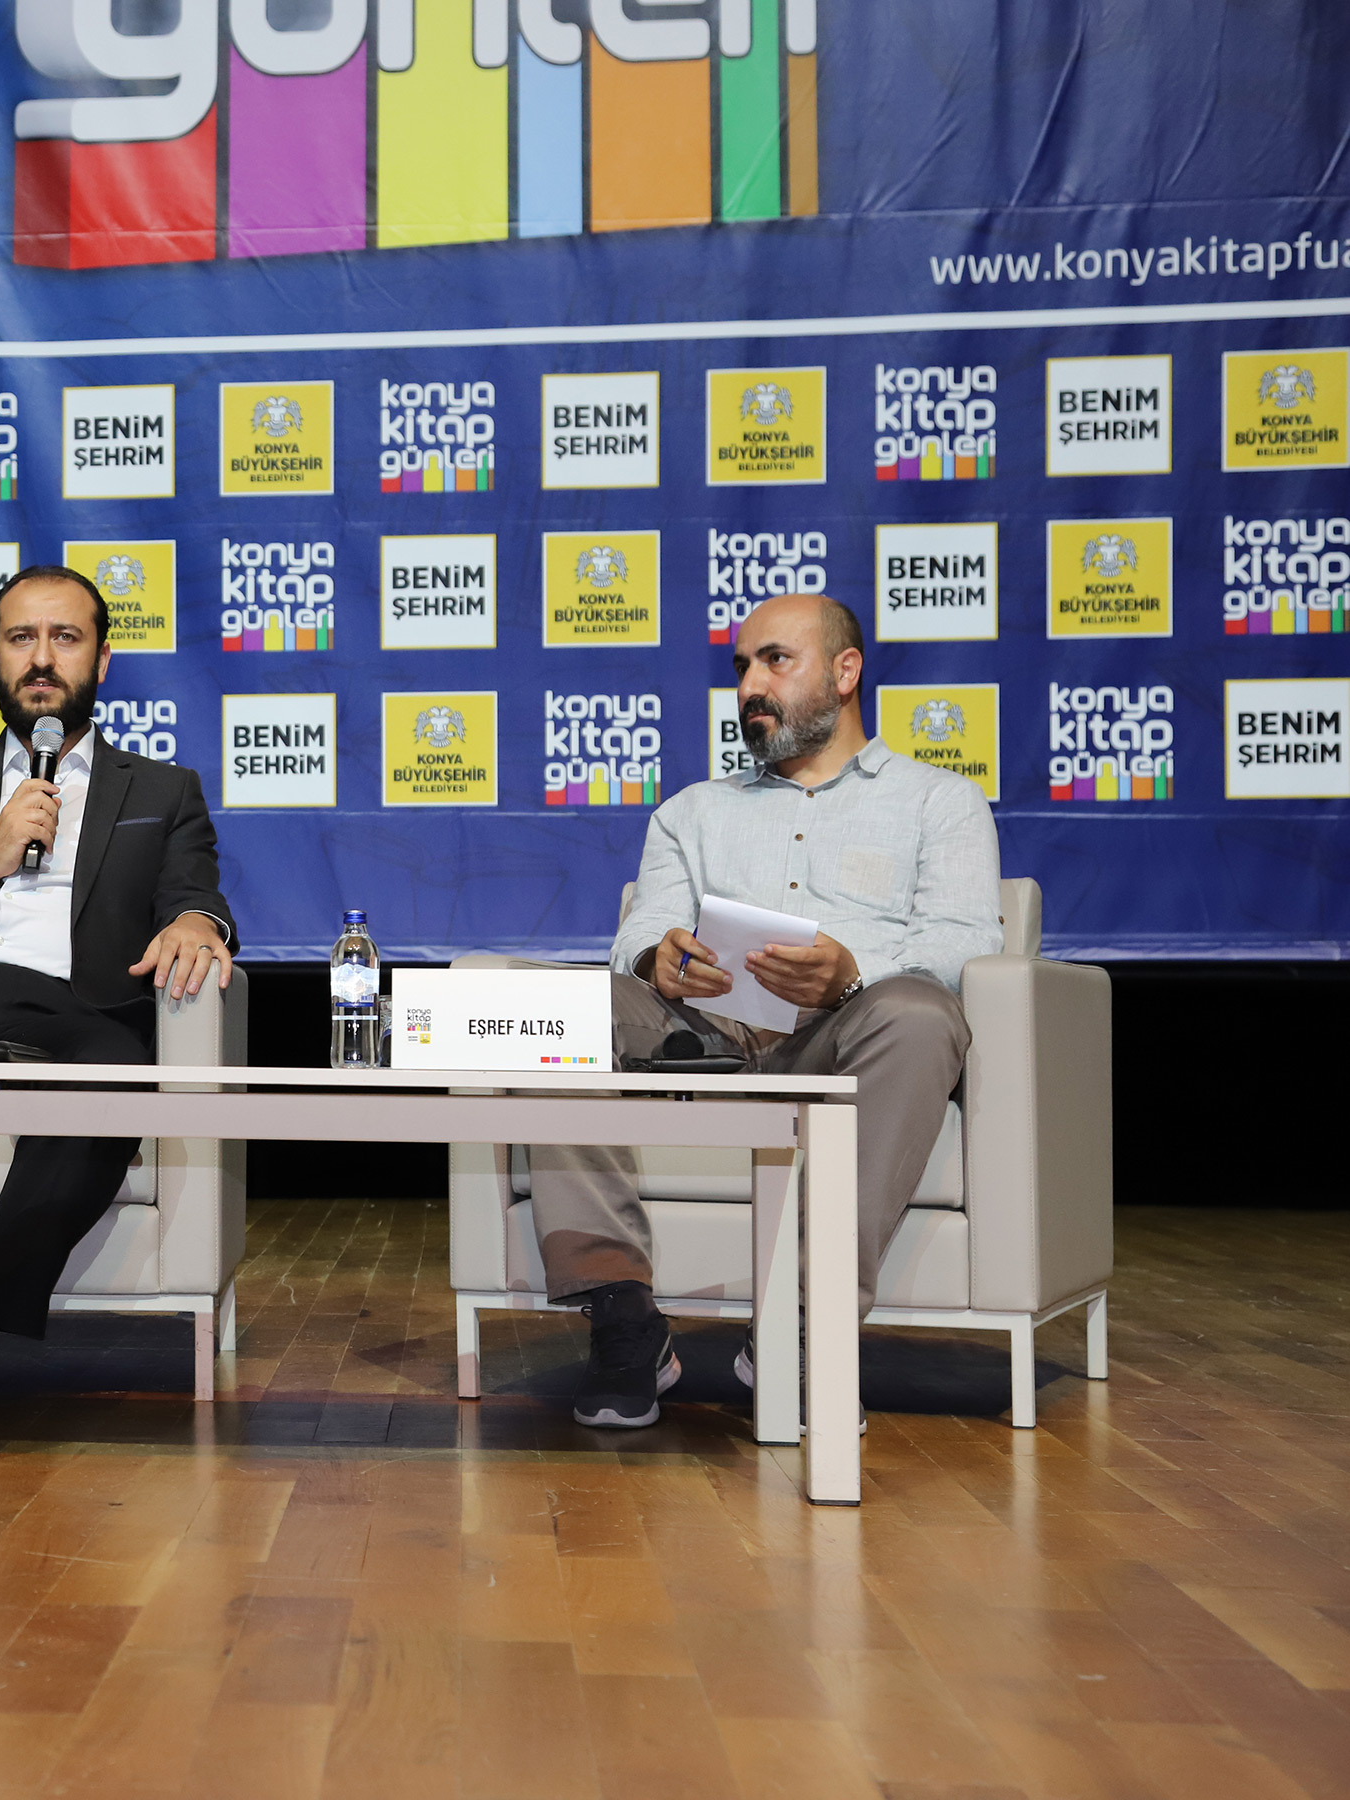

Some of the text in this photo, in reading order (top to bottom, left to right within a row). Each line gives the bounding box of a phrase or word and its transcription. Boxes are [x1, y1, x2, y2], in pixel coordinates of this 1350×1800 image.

[380, 379, 495, 415] konya
[875, 364, 996, 400] konya
[380, 408, 495, 449] kitap
[875, 393, 996, 435] kitap
[1262, 415, 1312, 427] KONYA
[255, 443, 299, 454] KONYA
[719, 443, 813, 461] BÜYÜKŞEHİR
[743, 431, 789, 442] KONYA
[875, 429, 996, 467] günleri
[1235, 426, 1338, 446] BÜYÜKŞEHİR
[232, 456, 322, 472] BÜYÜKŞEHİR
[380, 444, 495, 479] günleri
[708, 528, 828, 566] konya
[1224, 516, 1350, 552] konya
[222, 538, 334, 574] konya
[1224, 545, 1350, 586] kitap
[222, 567, 334, 608] kitap
[708, 558, 828, 596] kitap
[1085, 584, 1134, 595] KONYA
[107, 601, 143, 612] ONYA
[555, 606, 648, 623] BÜYÜKŞEHİR
[579, 594, 624, 605] KONYA
[1060, 596, 1159, 614] BÜYÜKŞEHİR
[1224, 581, 1350, 620] günleri
[109, 613, 166, 630] KŞEHİR
[222, 603, 334, 638] günleri
[93, 700, 177, 733] onya
[545, 691, 661, 727] konya
[1050, 682, 1173, 719] konya
[545, 720, 661, 761] kitap
[1050, 711, 1173, 754] kitap
[418, 754, 462, 765] KONYA
[914, 748, 963, 760] KONYA
[1050, 748, 1173, 786] günleri
[394, 766, 486, 783] BÜYÜKŞEHİR
[545, 756, 661, 791] günleri
[468, 1019, 565, 1040] EŞREF ALTAŞ
